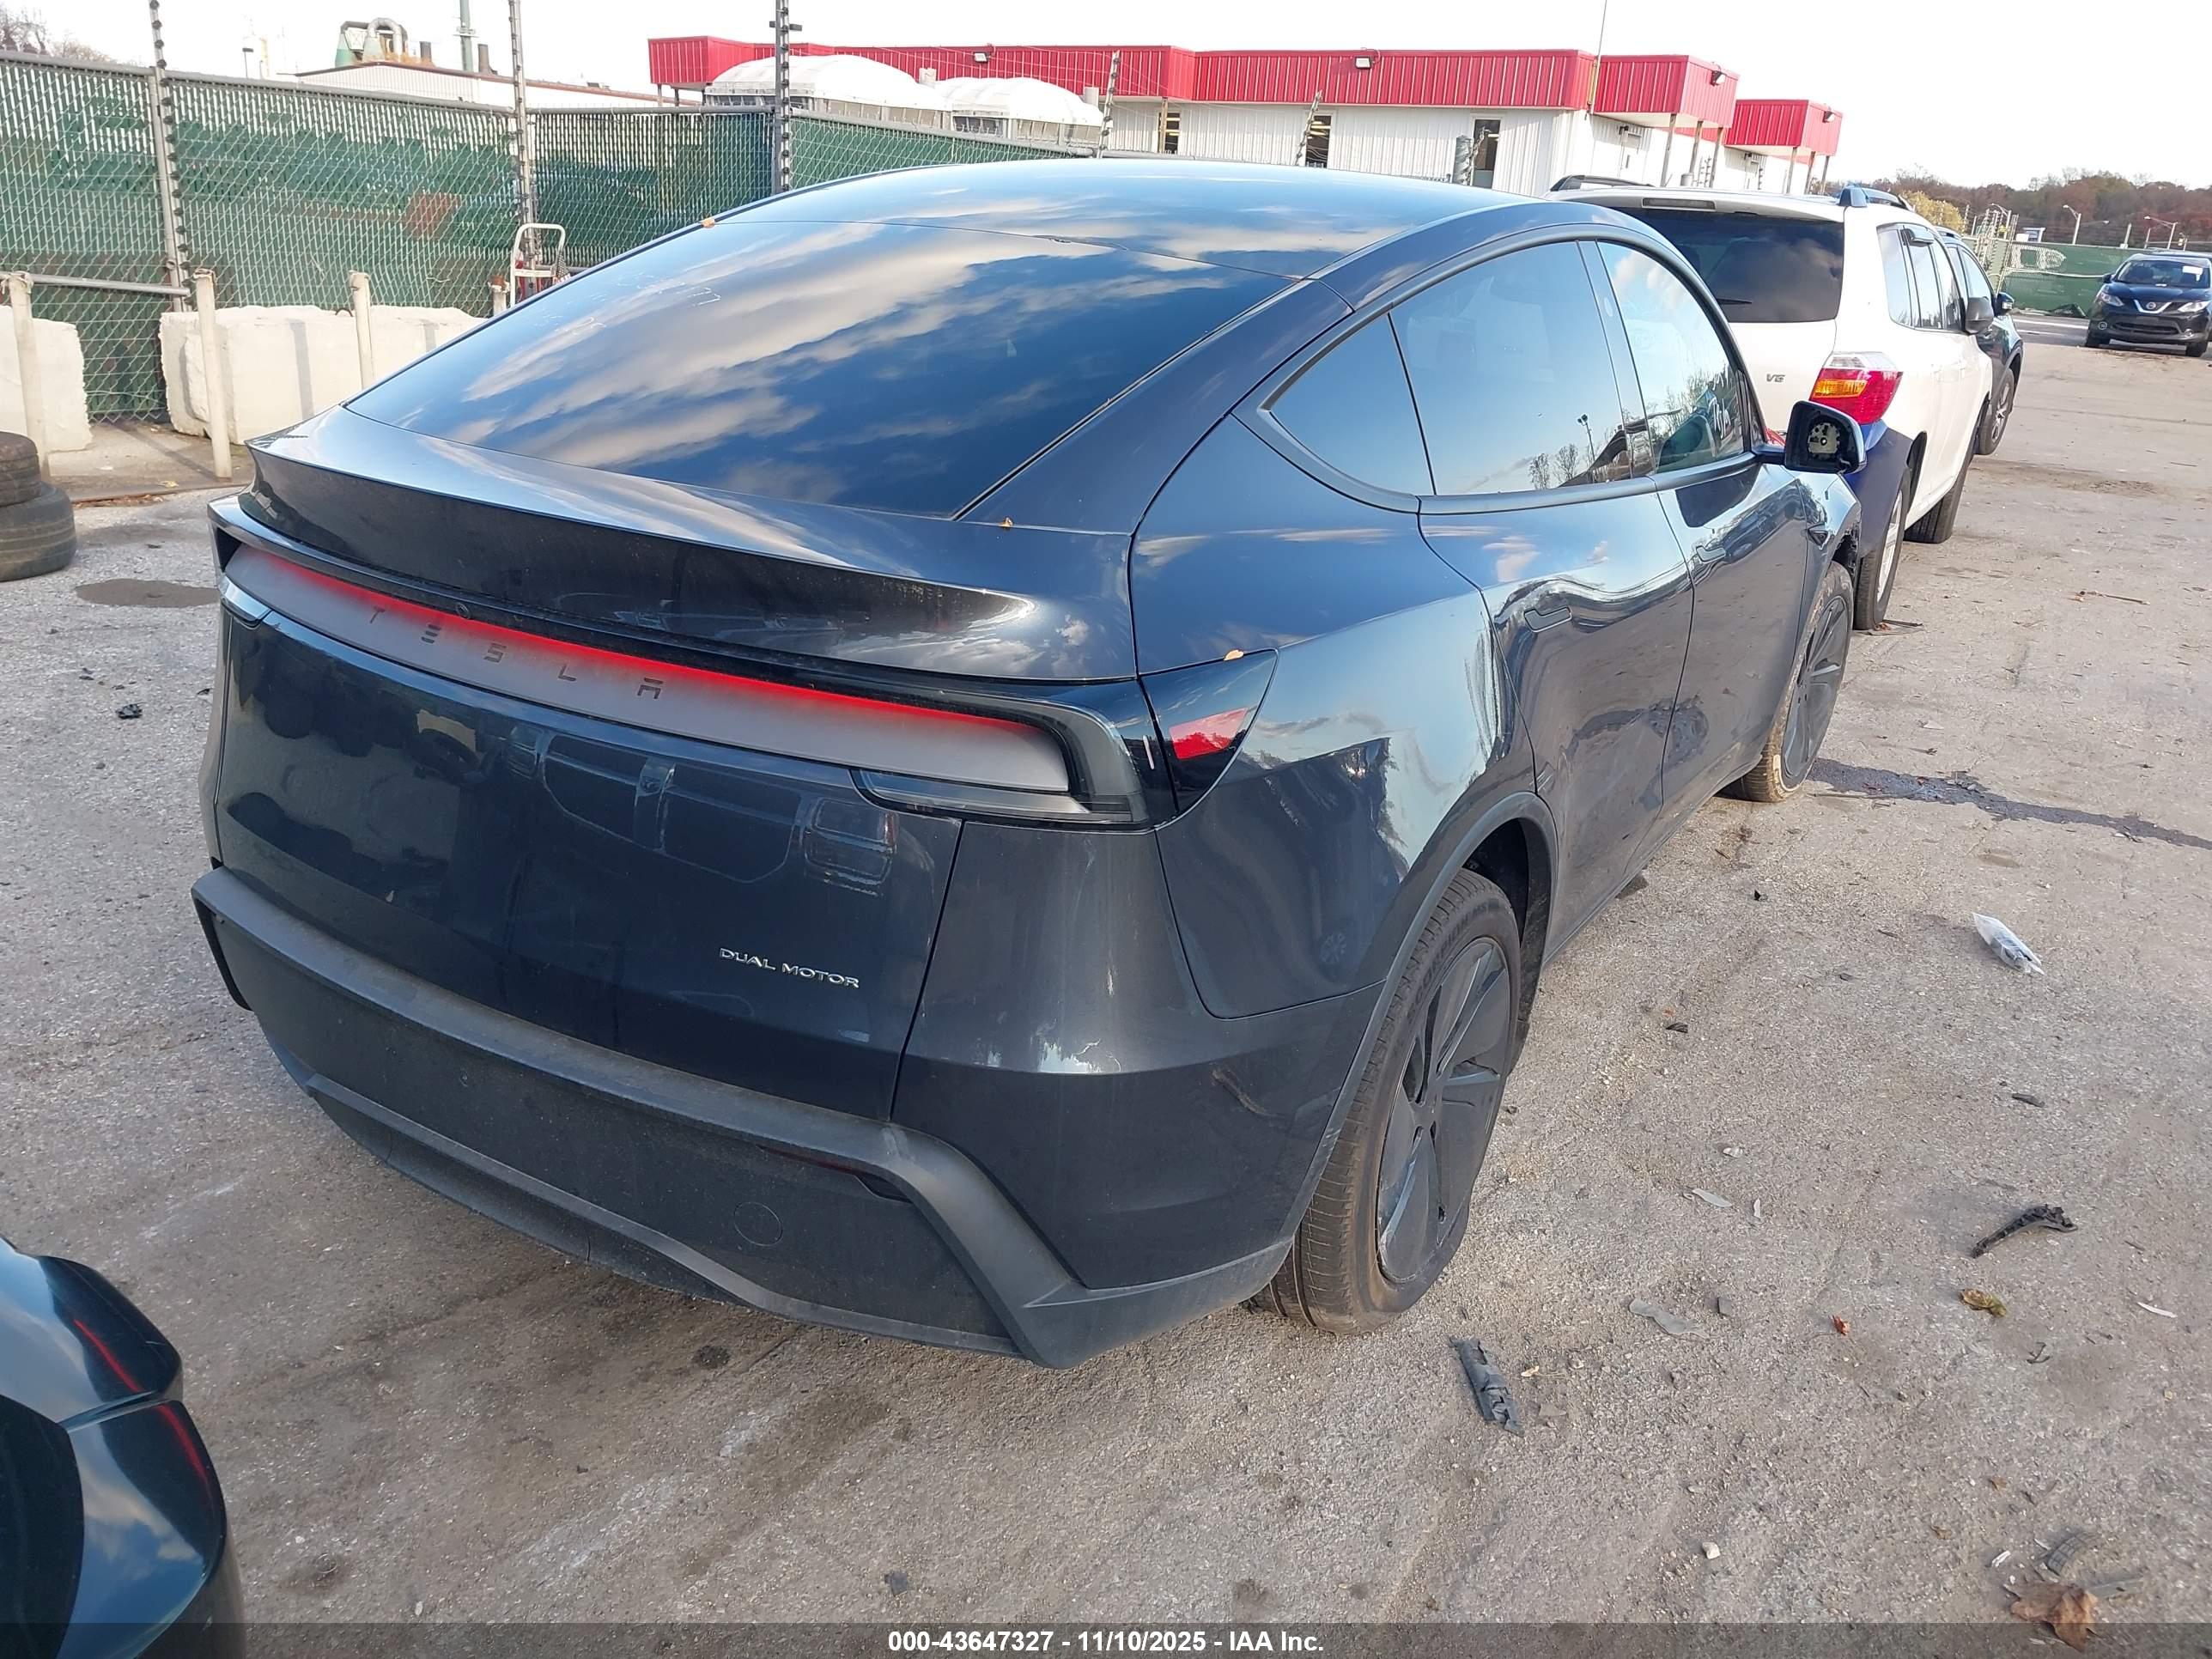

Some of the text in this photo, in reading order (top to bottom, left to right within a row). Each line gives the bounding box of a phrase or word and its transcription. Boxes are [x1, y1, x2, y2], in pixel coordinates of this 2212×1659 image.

[1766, 374, 1785, 383] V6
[368, 606, 663, 700] TESLA
[720, 947, 860, 988] DUAL MOTOR
